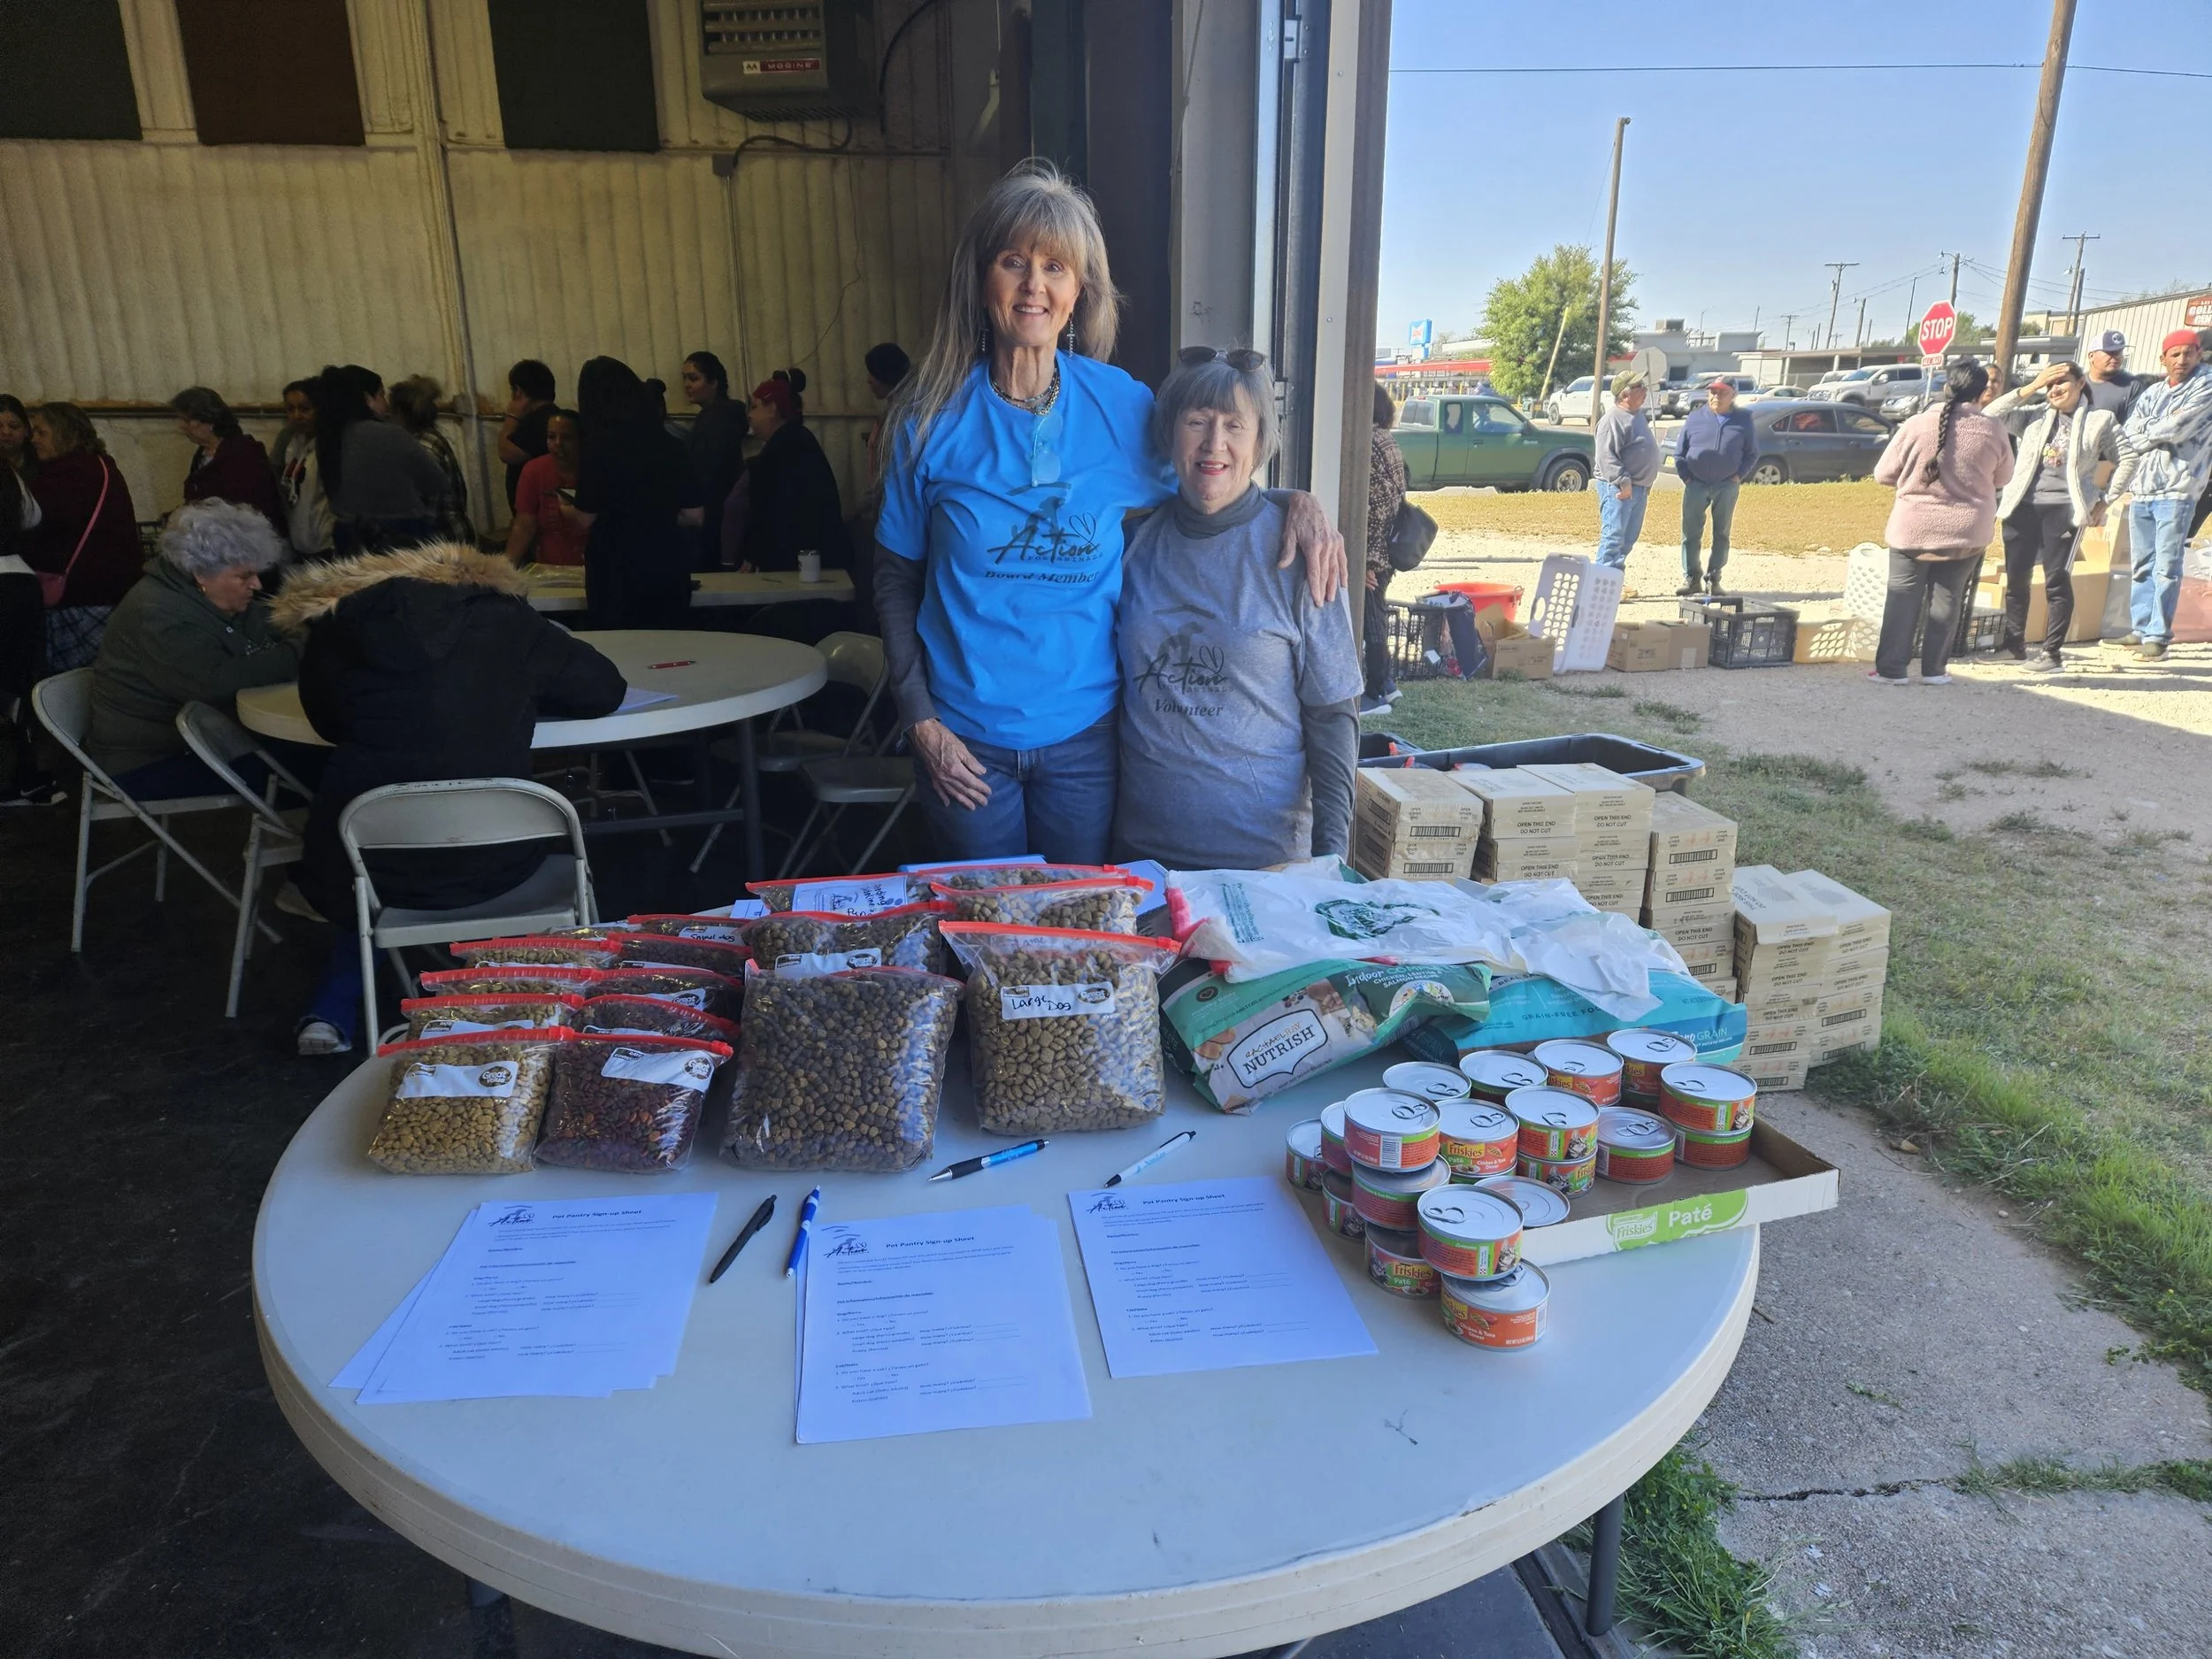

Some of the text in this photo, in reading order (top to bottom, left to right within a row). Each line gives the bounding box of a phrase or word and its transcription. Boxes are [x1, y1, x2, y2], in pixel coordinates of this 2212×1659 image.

[768, 61, 813, 70] MODINE
[1921, 317, 1954, 341] STOP
[987, 523, 1100, 565] Action
[984, 570, 1100, 584] Board Member
[1133, 654, 1229, 695] Action
[1154, 698, 1225, 717] Volunteer
[1345, 970, 1385, 987] Indoor
[1384, 976, 1413, 988] SALMON
[1498, 975, 1522, 987] REAL
[1012, 995, 1071, 1010] Large Dog
[1522, 1011, 1579, 1020] GRAIN-FREE
[1245, 1020, 1302, 1058] RACHAEL RAY
[1697, 1027, 1728, 1041] GRAIN
[1242, 1025, 1316, 1075] NUTRISH
[482, 1066, 508, 1079] Great
[1449, 1143, 1483, 1157] Friskies
[1617, 1203, 1713, 1239] Friskies Paté
[899, 1240, 924, 1248] Pantry
[1394, 1263, 1432, 1279] Friskies
